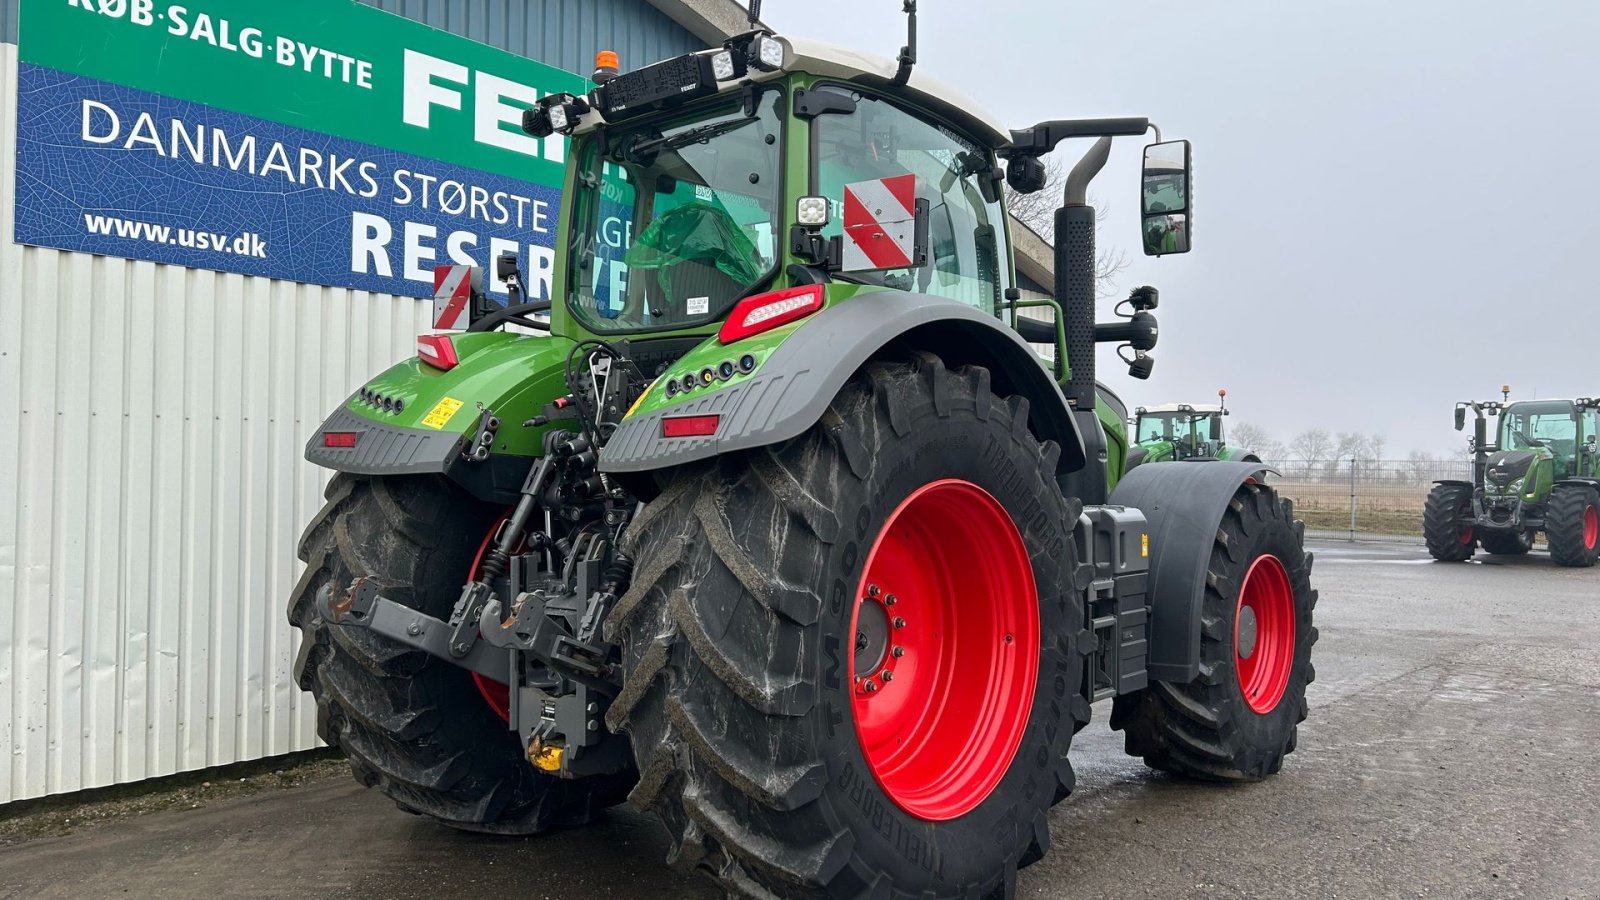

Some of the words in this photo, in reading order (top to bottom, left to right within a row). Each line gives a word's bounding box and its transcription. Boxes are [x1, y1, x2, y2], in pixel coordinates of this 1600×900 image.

[81, 99, 378, 198] DANMARKS
[393, 169, 549, 233] STØRSTE
[84, 213, 267, 258] www.usv.dk
[984, 432, 1065, 560] TRELLEBORG
[838, 760, 946, 882] TRELLEBORG
